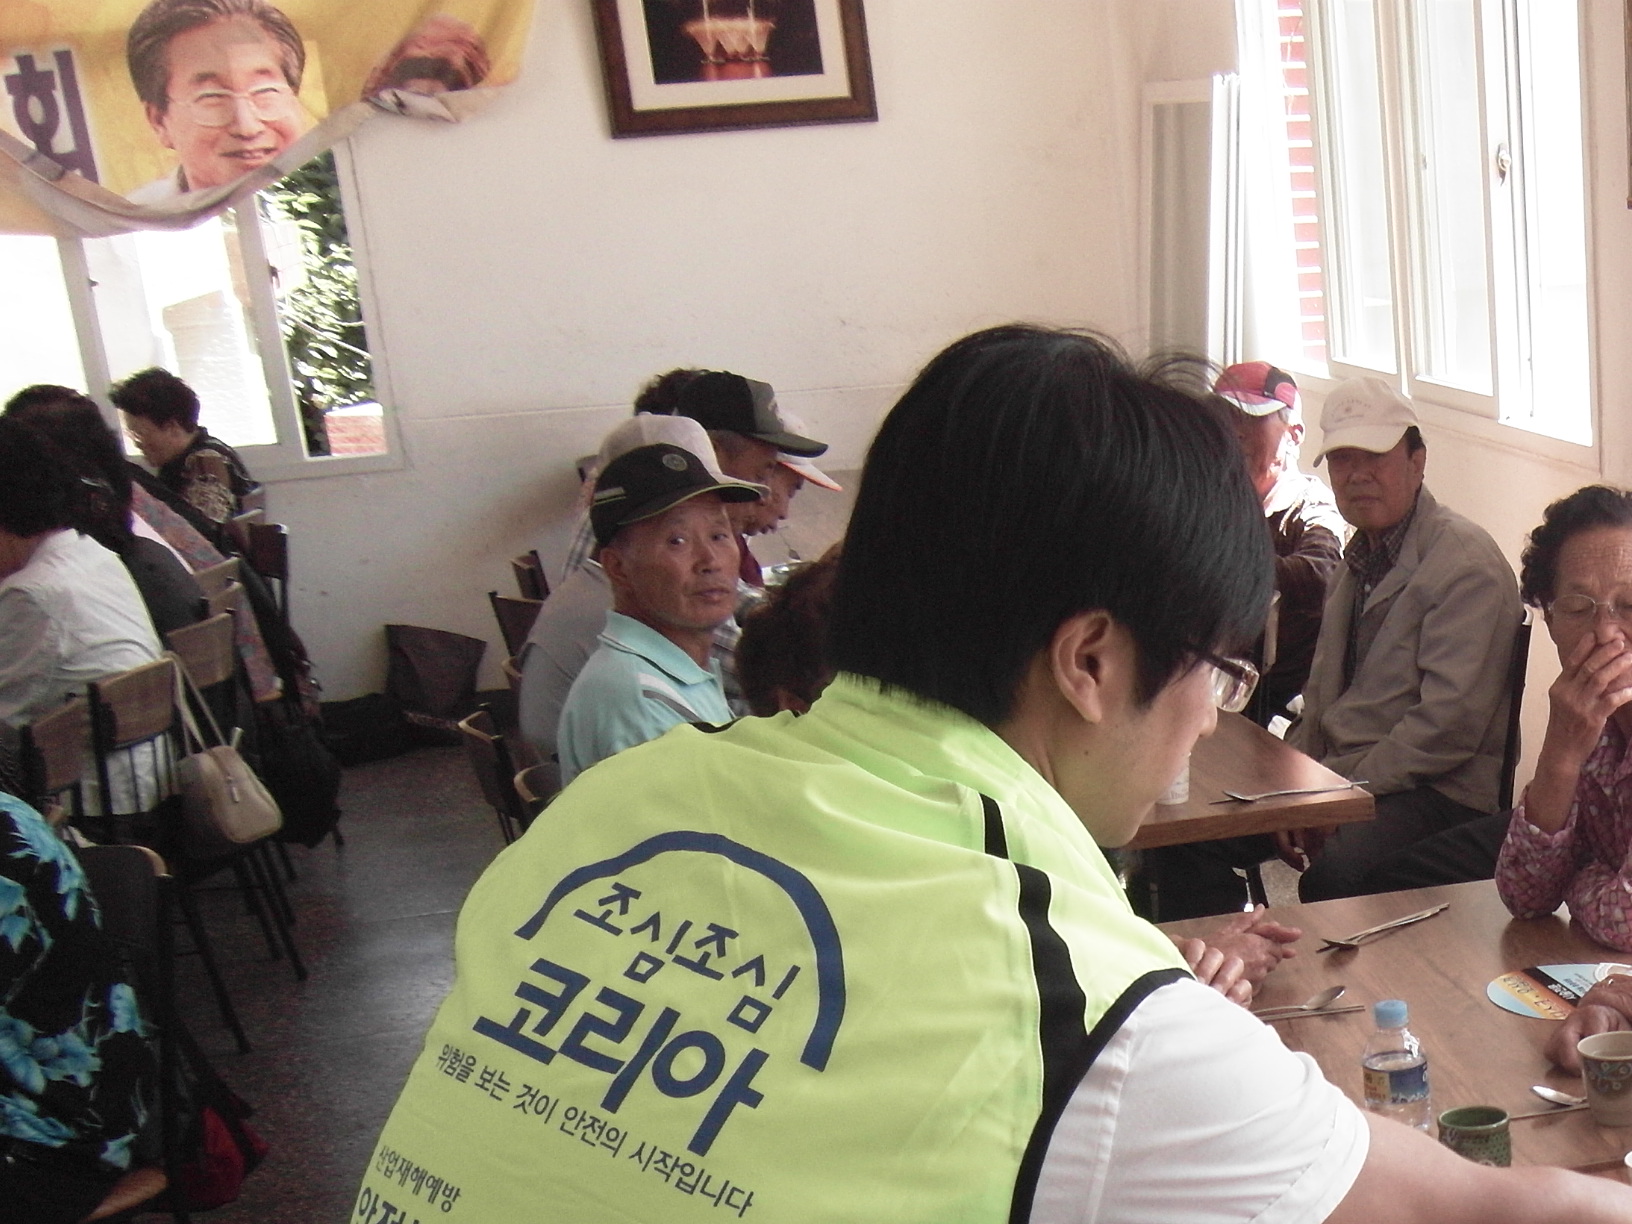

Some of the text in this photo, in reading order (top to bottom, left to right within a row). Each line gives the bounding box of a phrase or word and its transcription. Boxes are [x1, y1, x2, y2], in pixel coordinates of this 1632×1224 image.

[4, 49, 99, 186] 회
[574, 882, 800, 1033] 조심조심
[437, 1043, 754, 1217] 위험을 보는 것이 안전의 시작입니다
[472, 958, 769, 1157] 코리아
[378, 1145, 461, 1213] 산업재해예방
